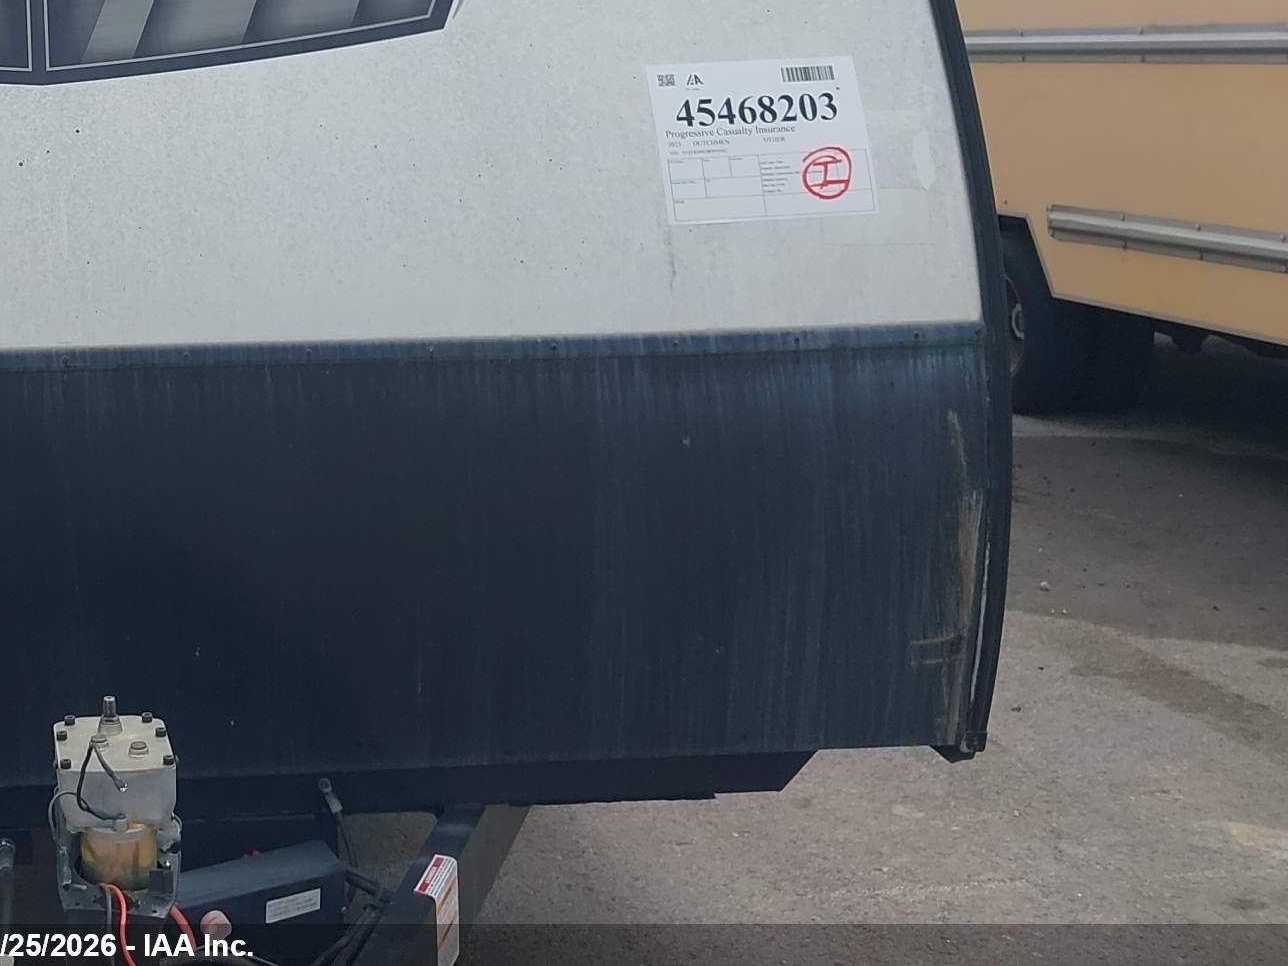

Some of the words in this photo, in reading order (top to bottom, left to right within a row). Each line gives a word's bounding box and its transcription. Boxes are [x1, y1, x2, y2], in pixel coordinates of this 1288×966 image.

[676, 92, 838, 127] 45468203
[665, 129, 714, 139] Progressive
[716, 126, 753, 137] Casualty
[755, 124, 796, 134] Insurance
